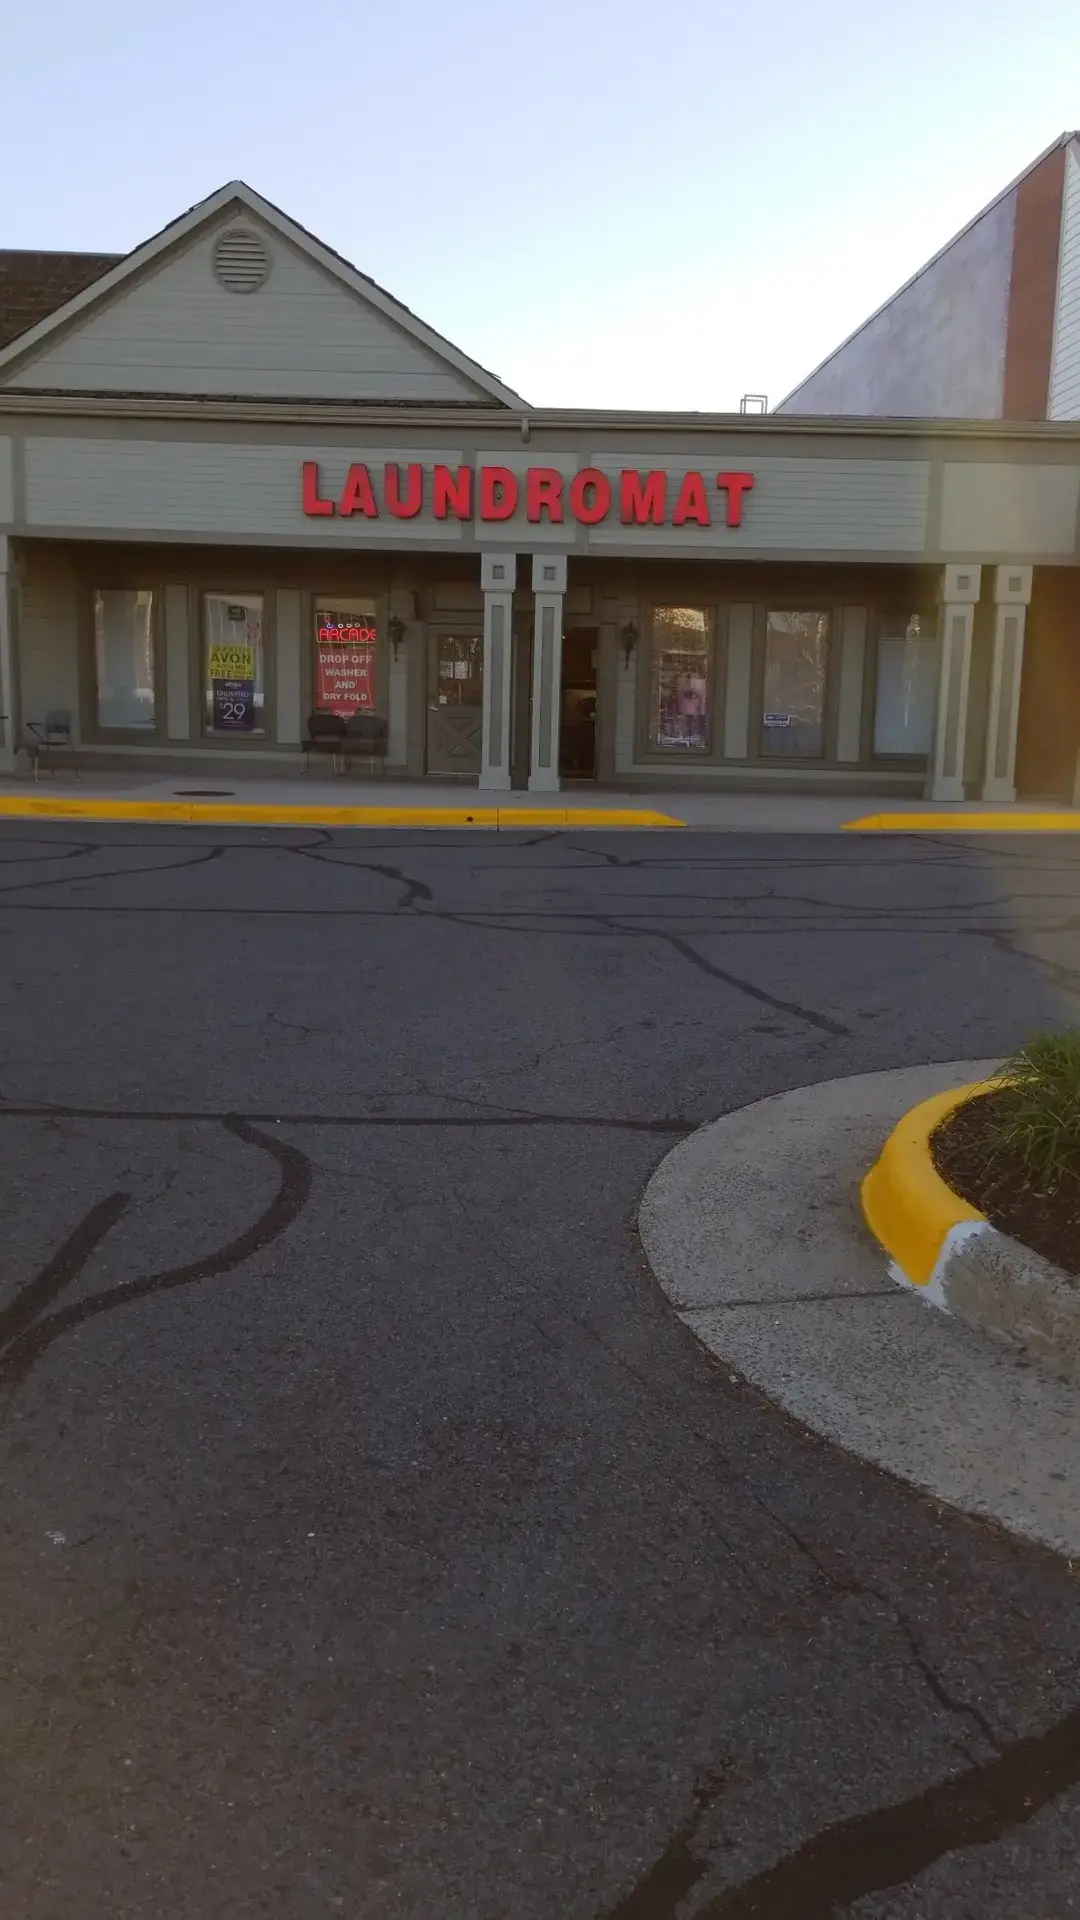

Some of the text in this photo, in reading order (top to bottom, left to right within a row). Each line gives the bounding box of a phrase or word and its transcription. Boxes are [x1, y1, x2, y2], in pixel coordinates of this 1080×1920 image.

[302, 461, 754, 528] LAUNDROMAT
[319, 628, 376, 641] ARCADE
[211, 652, 252, 664] AVON
[320, 654, 372, 664] DROP OFF
[210, 668, 233, 678] FREE
[325, 668, 367, 677] WASHER
[335, 681, 355, 689] AND
[324, 693, 368, 701] DRY FOLD
